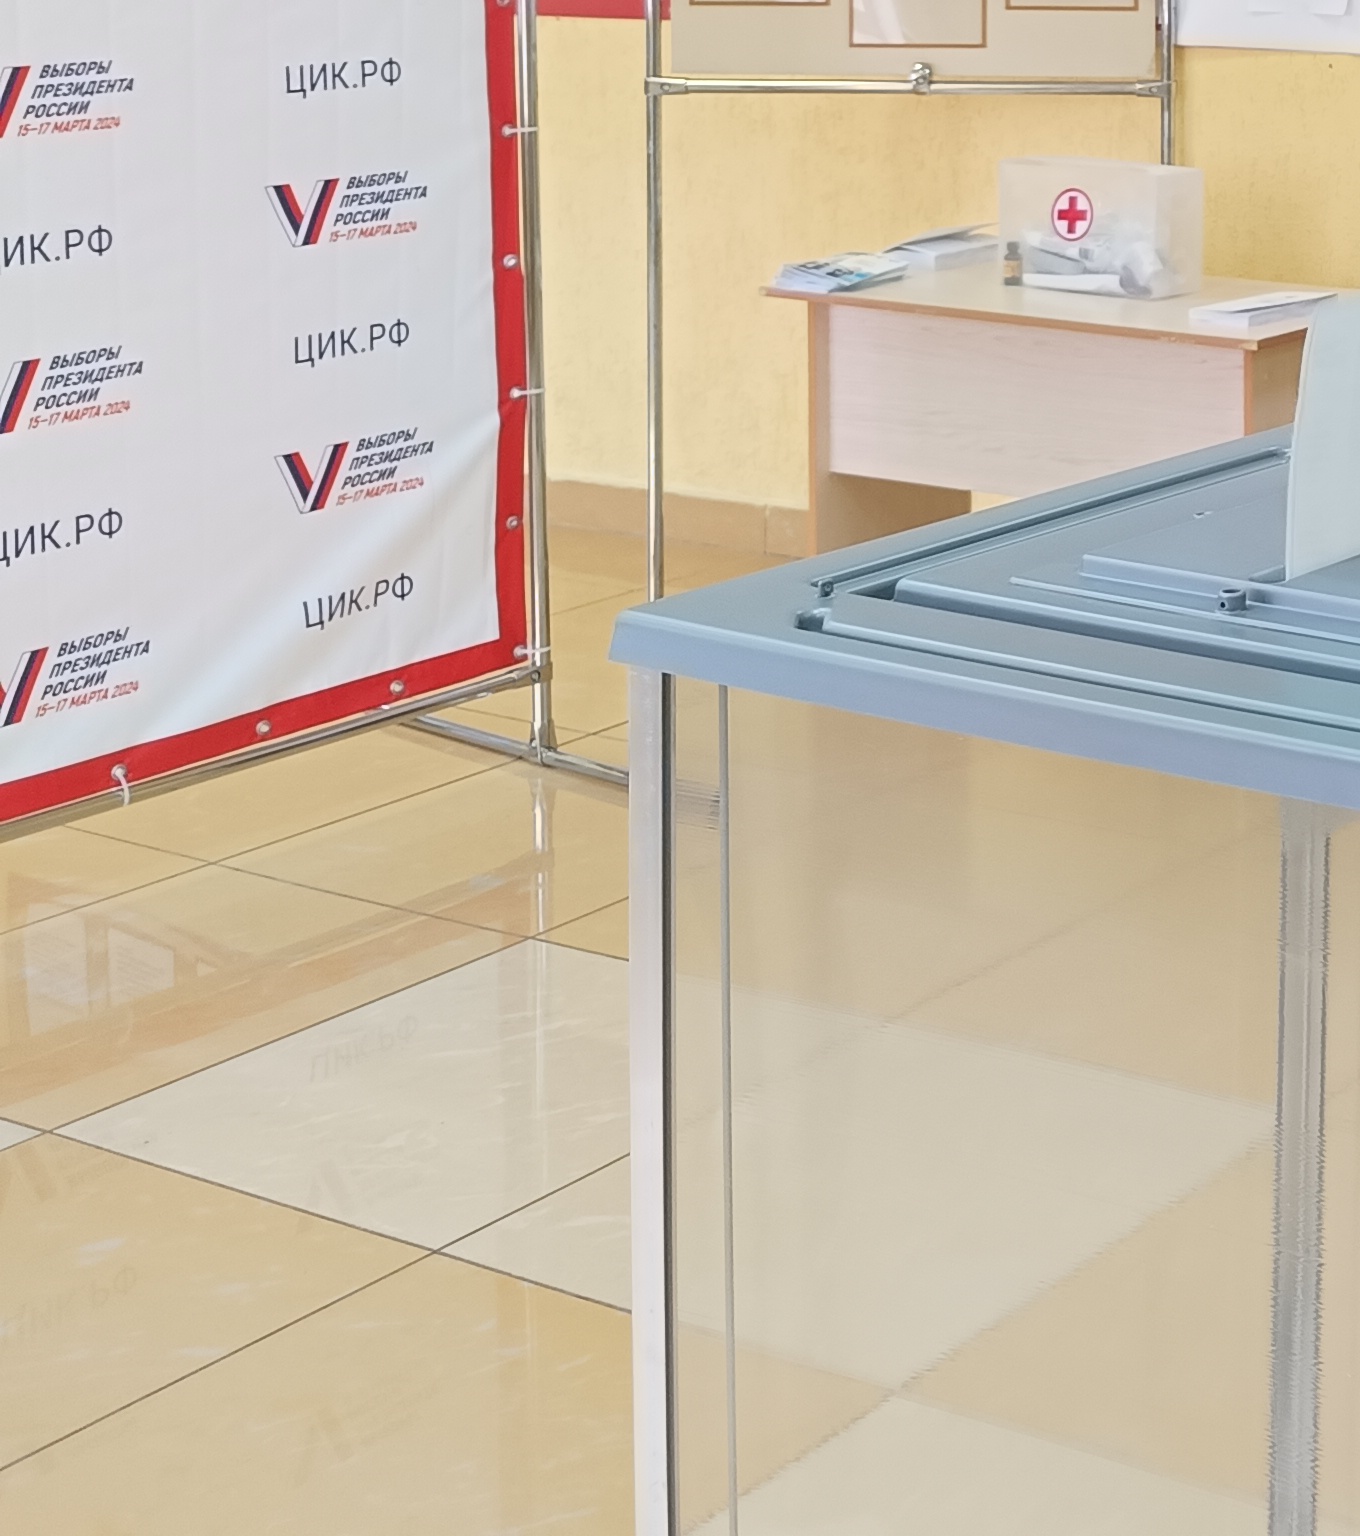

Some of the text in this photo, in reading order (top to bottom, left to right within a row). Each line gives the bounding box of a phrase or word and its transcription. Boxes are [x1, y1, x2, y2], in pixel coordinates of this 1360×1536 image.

[38, 59, 112, 78] ВЫБОРЫ
[285, 57, 402, 99] ЦИК.РФ
[30, 77, 134, 99] ПРЕЗИДЕНТА
[22, 100, 90, 119] РОССИИ
[345, 170, 408, 189] ВЫБОРЫ
[339, 185, 427, 208] ПРЕЗИДЕНТА
[333, 207, 391, 226] РОССИИ
[2, 224, 113, 268] ИК.РФ
[293, 318, 410, 368] ЦИК.РФ
[48, 345, 122, 370] ВЫБОРЫ
[40, 360, 143, 391] ПРЕЗИДЕНТА
[32, 386, 100, 411] РОССИИ
[355, 426, 417, 452] ВЫБОРЫ
[348, 440, 434, 471] ПРЕЗИДЕНТА
[340, 465, 397, 489] РОССИИ
[302, 572, 414, 631] ЦИК.РФ
[56, 626, 129, 657] ВЫБОРЫ
[48, 639, 150, 679] ПРЕЗИДЕНТА
[40, 669, 107, 700] РОССИИ
